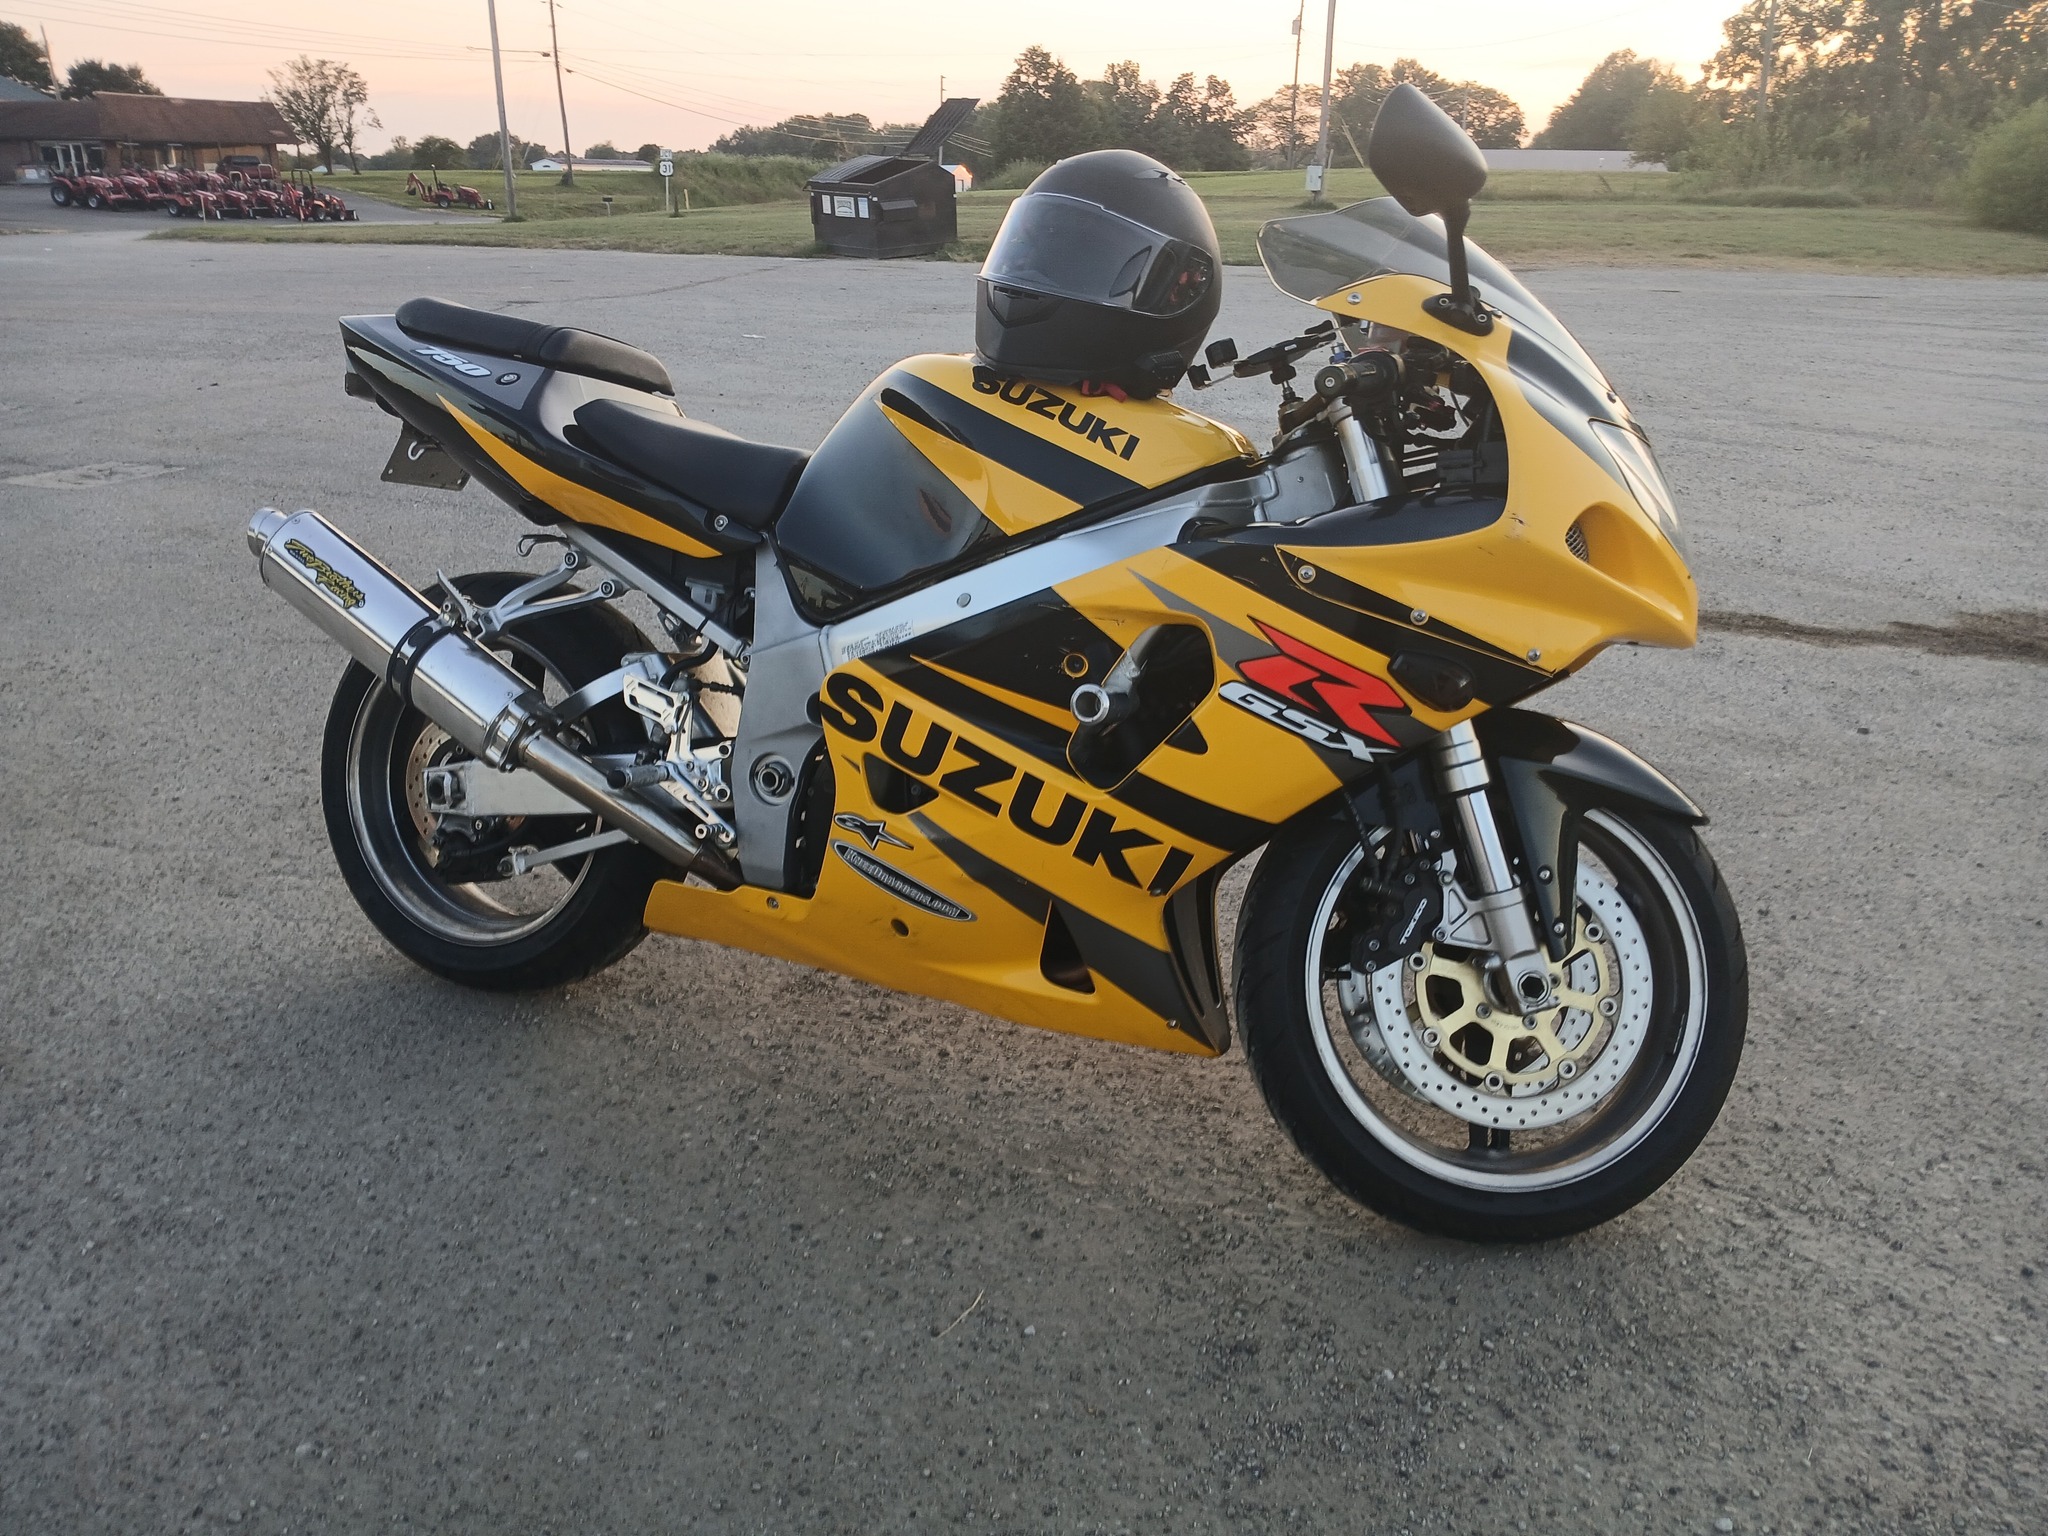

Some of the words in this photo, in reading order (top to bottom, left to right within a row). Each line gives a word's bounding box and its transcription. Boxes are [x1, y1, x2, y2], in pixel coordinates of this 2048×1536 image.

[662, 164, 671, 173] 31
[414, 345, 492, 377] 750
[1237, 616, 1406, 747] R
[820, 672, 1195, 897] SUZUKI
[1399, 897, 1428, 945] TOKICO
